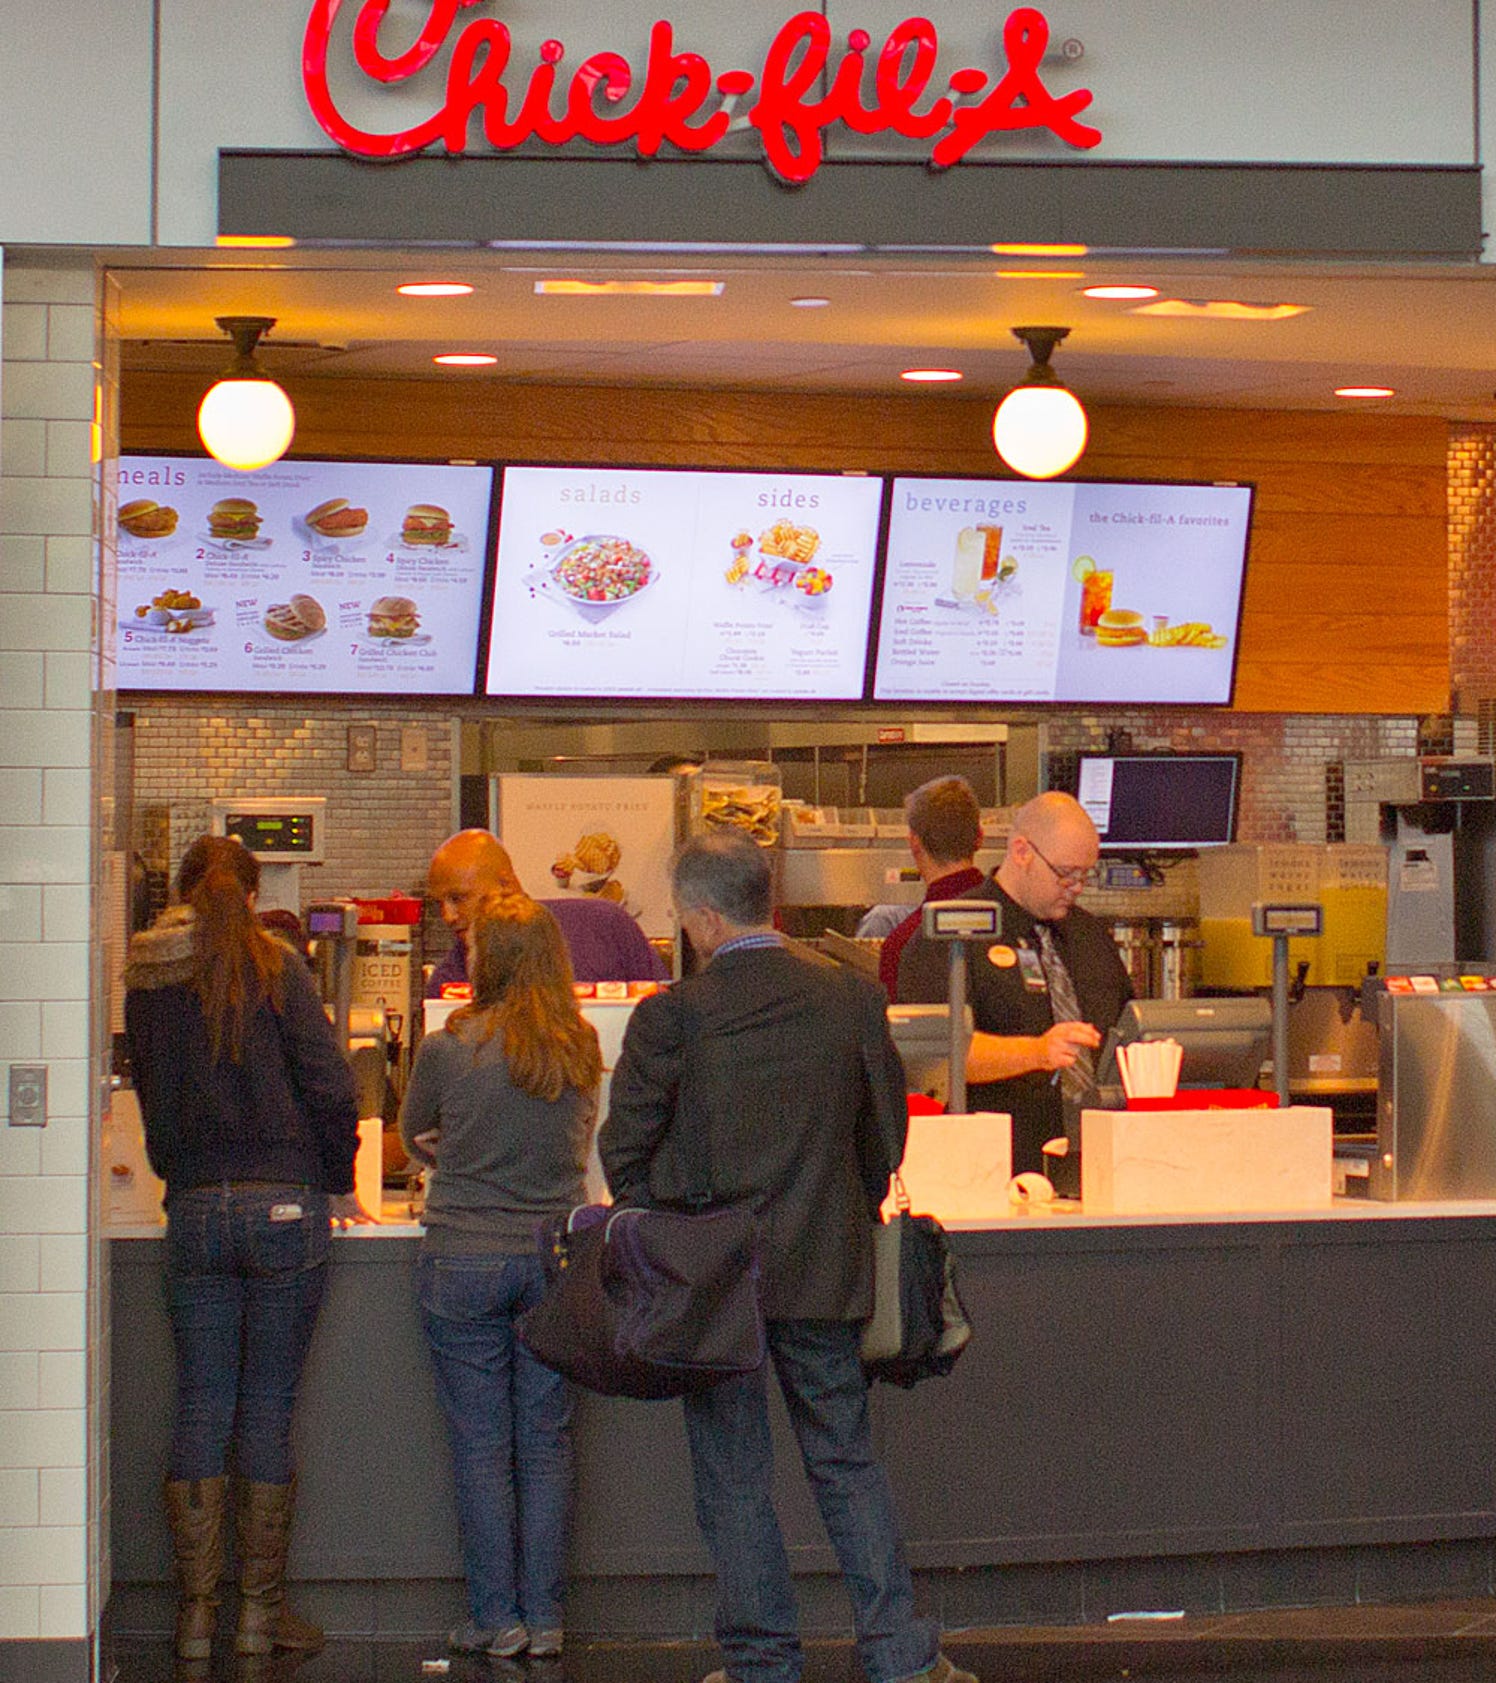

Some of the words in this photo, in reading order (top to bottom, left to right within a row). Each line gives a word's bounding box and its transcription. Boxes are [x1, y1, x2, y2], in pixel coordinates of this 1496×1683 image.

[303, 0, 1102, 184] Chick-fil-A
[560, 485, 642, 503] salads
[758, 489, 820, 508] sides
[906, 492, 1027, 518] beverages
[1090, 513, 1109, 523] the
[1112, 513, 1174, 525] Chick-fil-A
[1179, 515, 1230, 527] favorites
[196, 548, 205, 559] 2
[302, 550, 311, 561] 3
[386, 552, 395, 564] 4
[124, 631, 133, 642] 5
[244, 642, 253, 653] 6
[351, 645, 359, 655] 7
[362, 964, 402, 977] ICED
